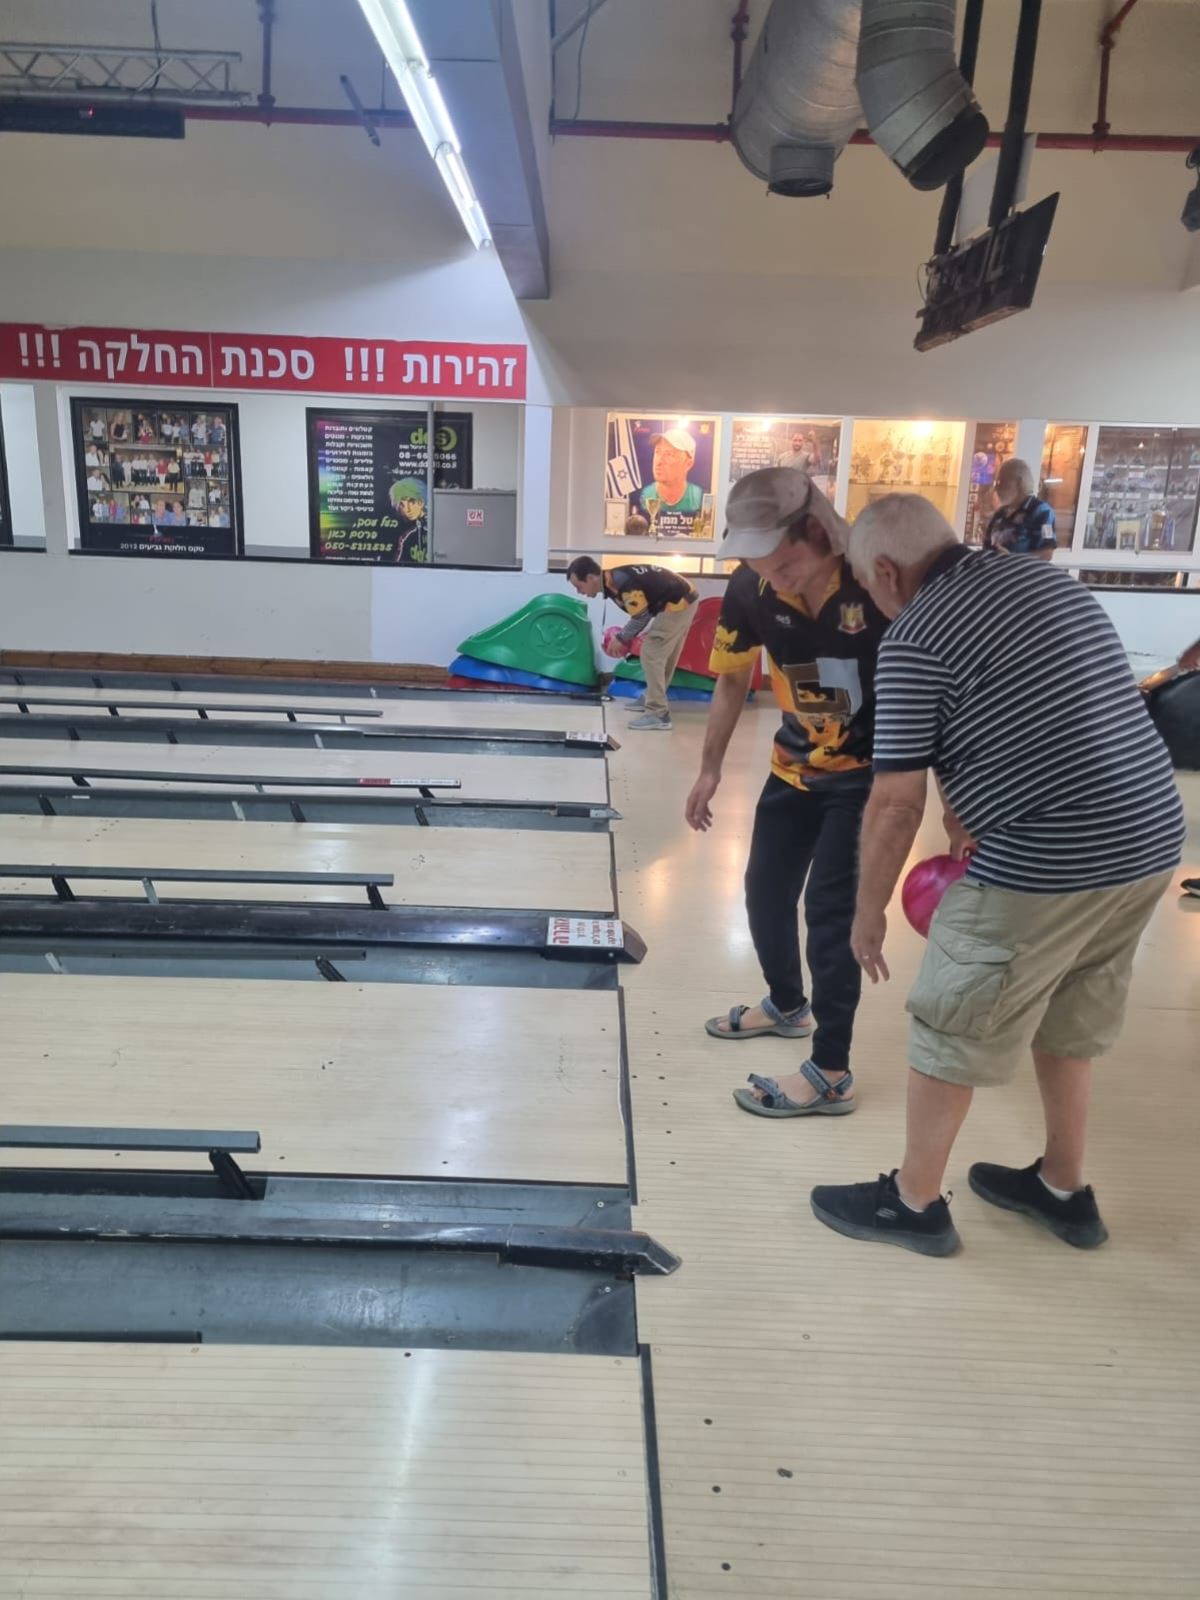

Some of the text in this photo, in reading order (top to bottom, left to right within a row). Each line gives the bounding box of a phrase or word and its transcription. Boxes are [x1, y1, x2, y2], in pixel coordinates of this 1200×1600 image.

[19, 332, 518, 387] זהירות !!! סכנת החלקה !!!
[380, 515, 398, 528] בעל
[468, 511, 483, 520] אש
[327, 529, 346, 541] כאן
[187, 545, 205, 553] טקס
